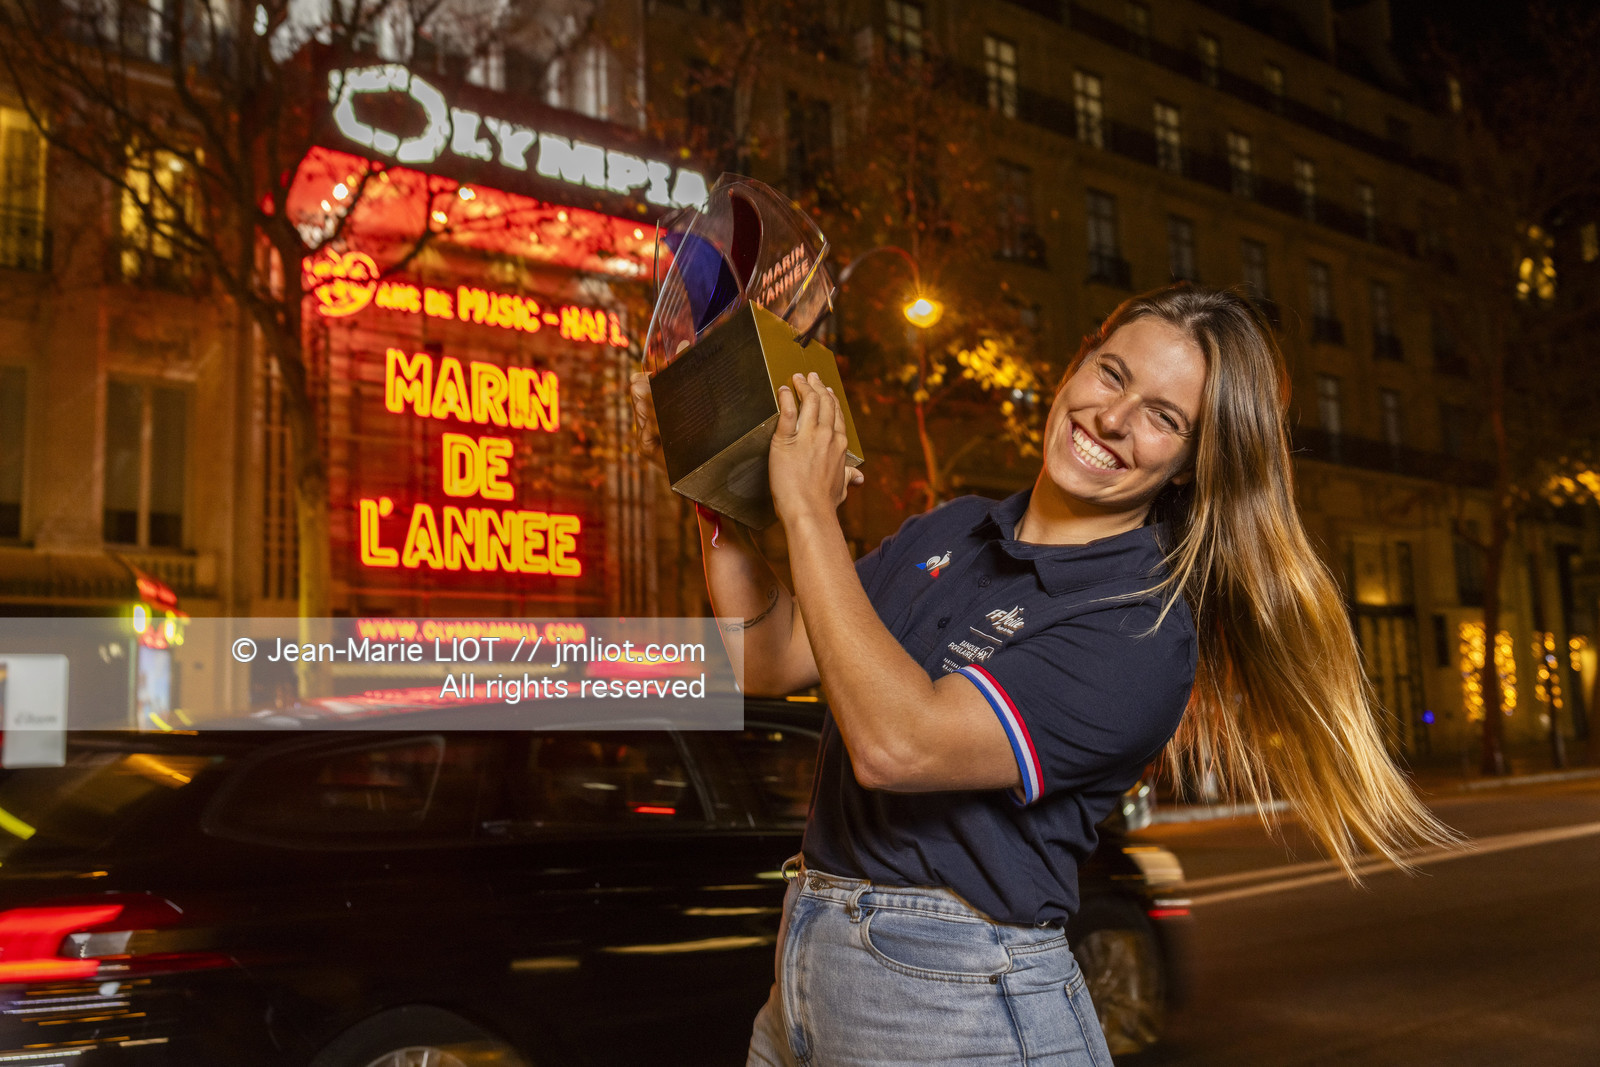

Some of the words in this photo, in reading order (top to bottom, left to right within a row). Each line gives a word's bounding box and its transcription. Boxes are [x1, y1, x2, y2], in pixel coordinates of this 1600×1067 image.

[328, 64, 709, 214] OLYMPIA
[762, 242, 805, 290] MARIN
[385, 347, 560, 433] MARIN
[442, 432, 515, 501] DE
[359, 496, 582, 577] L'ANNEE
